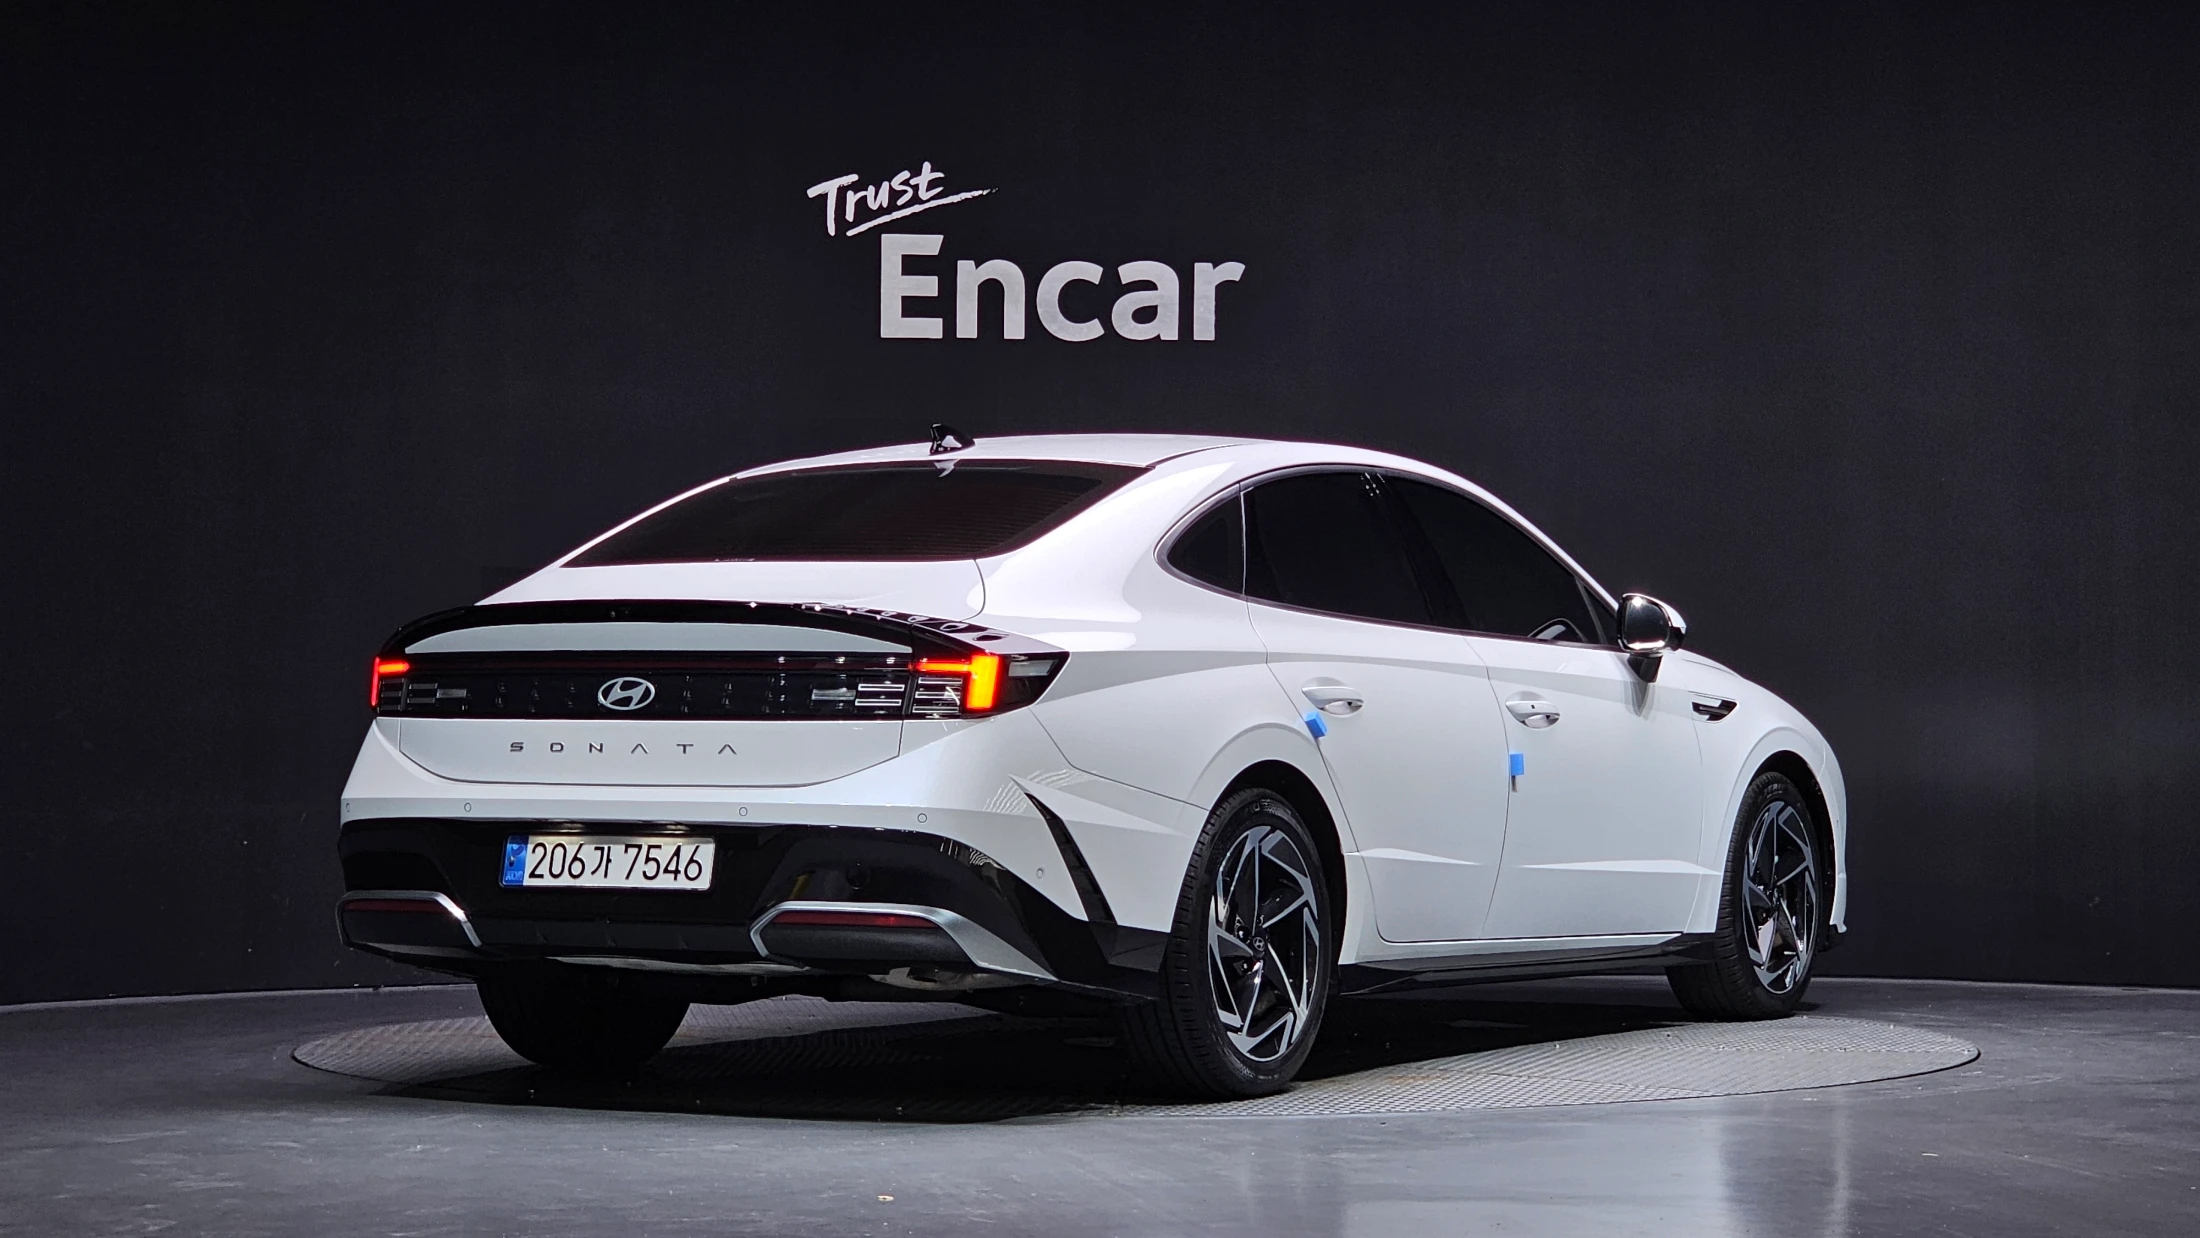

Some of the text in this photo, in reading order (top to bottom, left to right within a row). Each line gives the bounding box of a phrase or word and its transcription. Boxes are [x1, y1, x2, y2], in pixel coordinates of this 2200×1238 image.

[806, 161, 945, 237] Trust
[880, 233, 1246, 342] Encar
[509, 741, 738, 756] SONATA
[528, 841, 703, 882] 206가 7546
